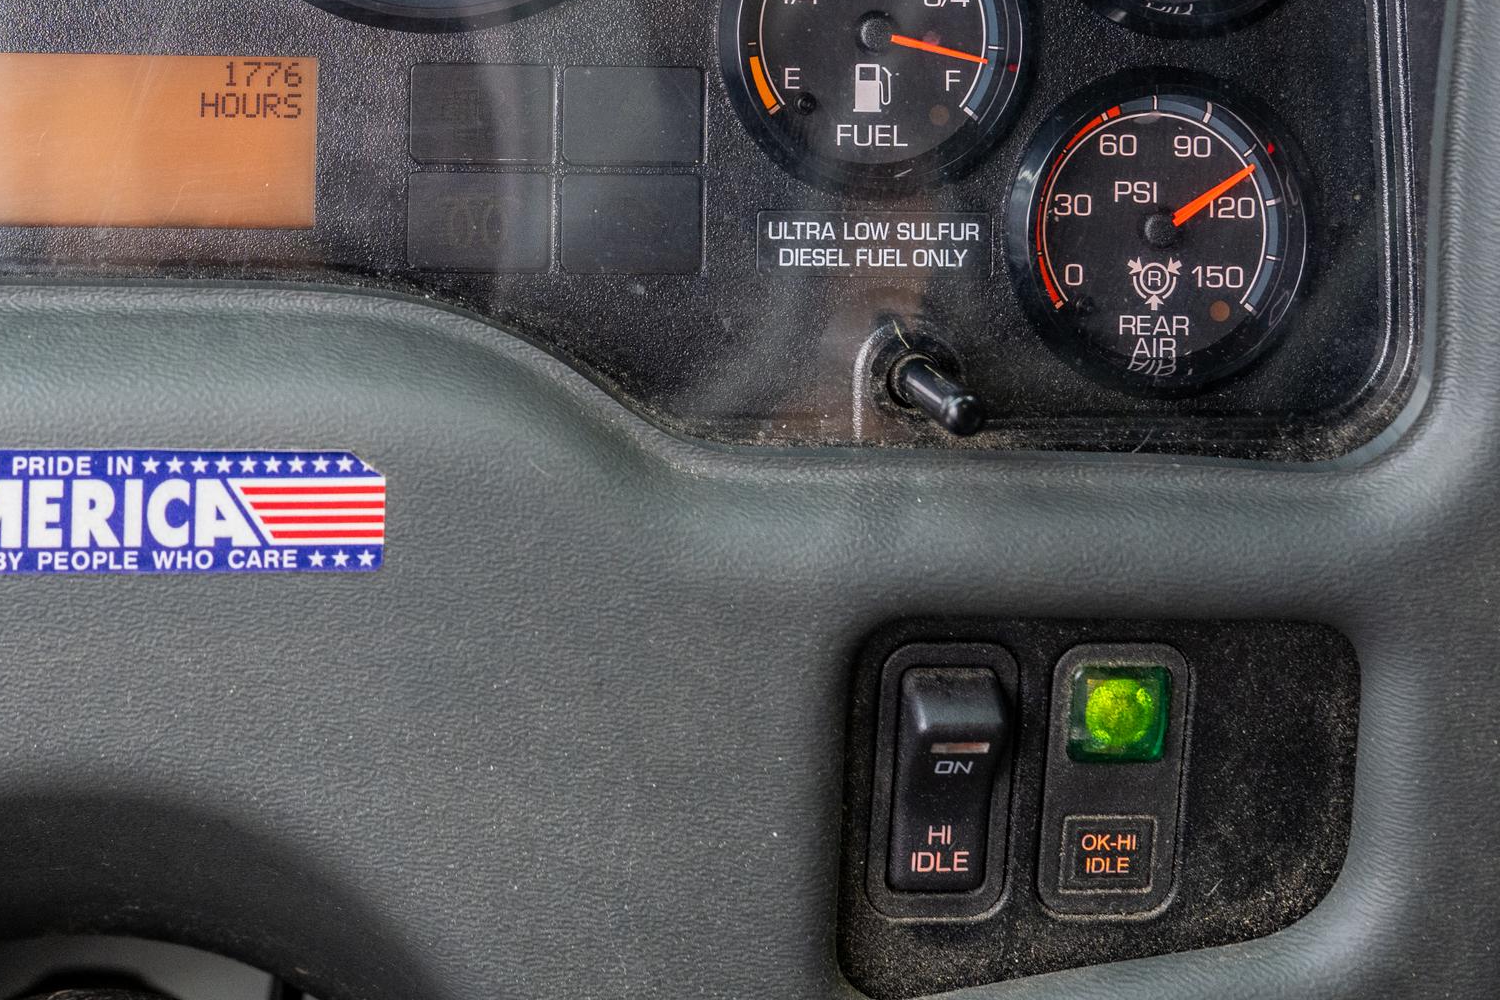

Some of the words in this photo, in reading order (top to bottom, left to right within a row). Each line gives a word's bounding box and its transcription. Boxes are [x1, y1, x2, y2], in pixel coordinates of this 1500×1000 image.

[225, 62, 302, 88] 1776
[784, 67, 800, 89] E
[945, 70, 961, 91] F
[200, 92, 302, 119] HOURS
[836, 124, 908, 147] FUEL
[1100, 134, 1137, 156] 60
[1174, 136, 1211, 158] 90
[1114, 181, 1158, 203] PSI
[1054, 194, 1092, 216] 30
[1206, 197, 1255, 219] 120
[768, 222, 835, 240] ULTRA
[844, 222, 890, 240] LOW
[896, 222, 980, 241] SULFUR
[779, 248, 850, 267] DIESEL
[856, 248, 908, 267] FUEL
[912, 249, 968, 267] ONLY
[1065, 264, 1084, 286] 0
[1191, 266, 1244, 288] 150
[1119, 315, 1189, 336] REAR
[1132, 338, 1176, 358] AIR
[12, 456, 91, 477] PRIDE
[107, 456, 134, 476] IN
[37, 550, 138, 570] PEOPLE
[152, 550, 214, 570] WHO
[228, 549, 298, 569] CARE
[934, 761, 973, 775] ON
[927, 825, 952, 845] HI
[1081, 834, 1138, 852] OK-HI
[911, 851, 970, 873] IDLE
[1085, 857, 1130, 875] IDLE
